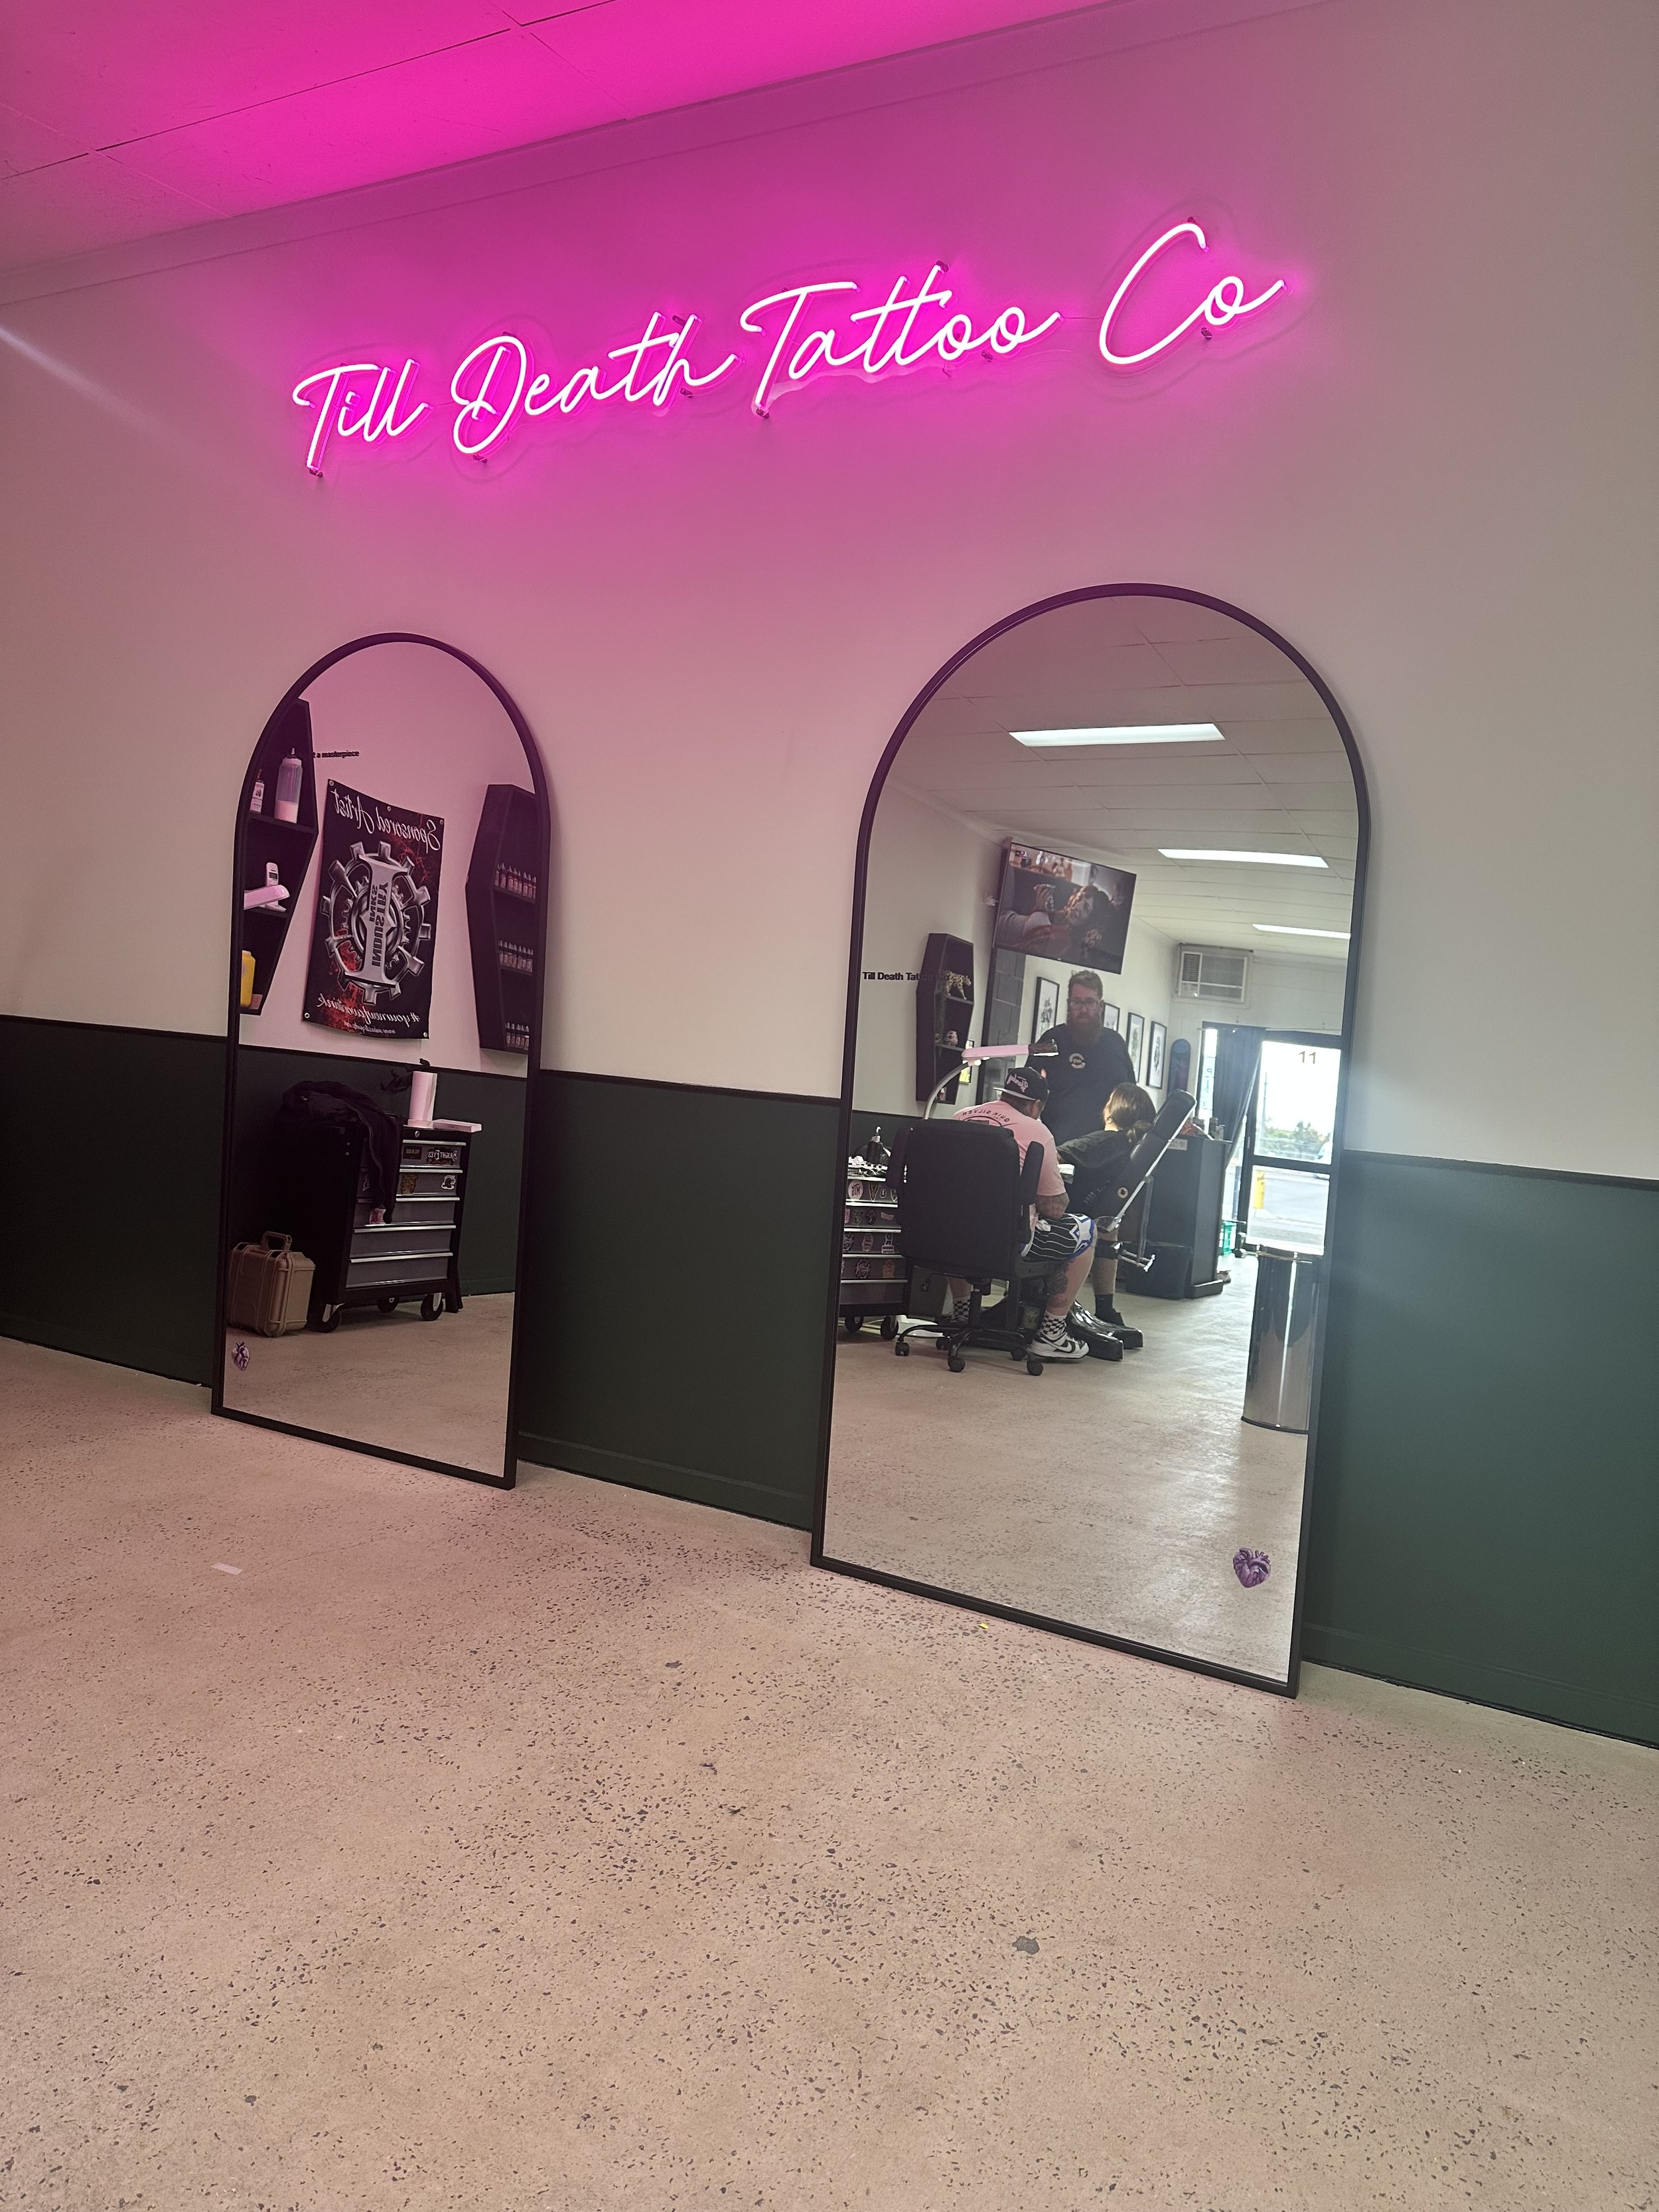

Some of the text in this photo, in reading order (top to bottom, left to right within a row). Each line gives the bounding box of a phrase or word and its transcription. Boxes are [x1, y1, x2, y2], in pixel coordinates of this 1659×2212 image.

[292, 222, 1284, 471] Till Death Tattoo Co
[862, 972, 875, 980] Till
[877, 972, 904, 981] Death
[1298, 1051, 1317, 1065] 11
